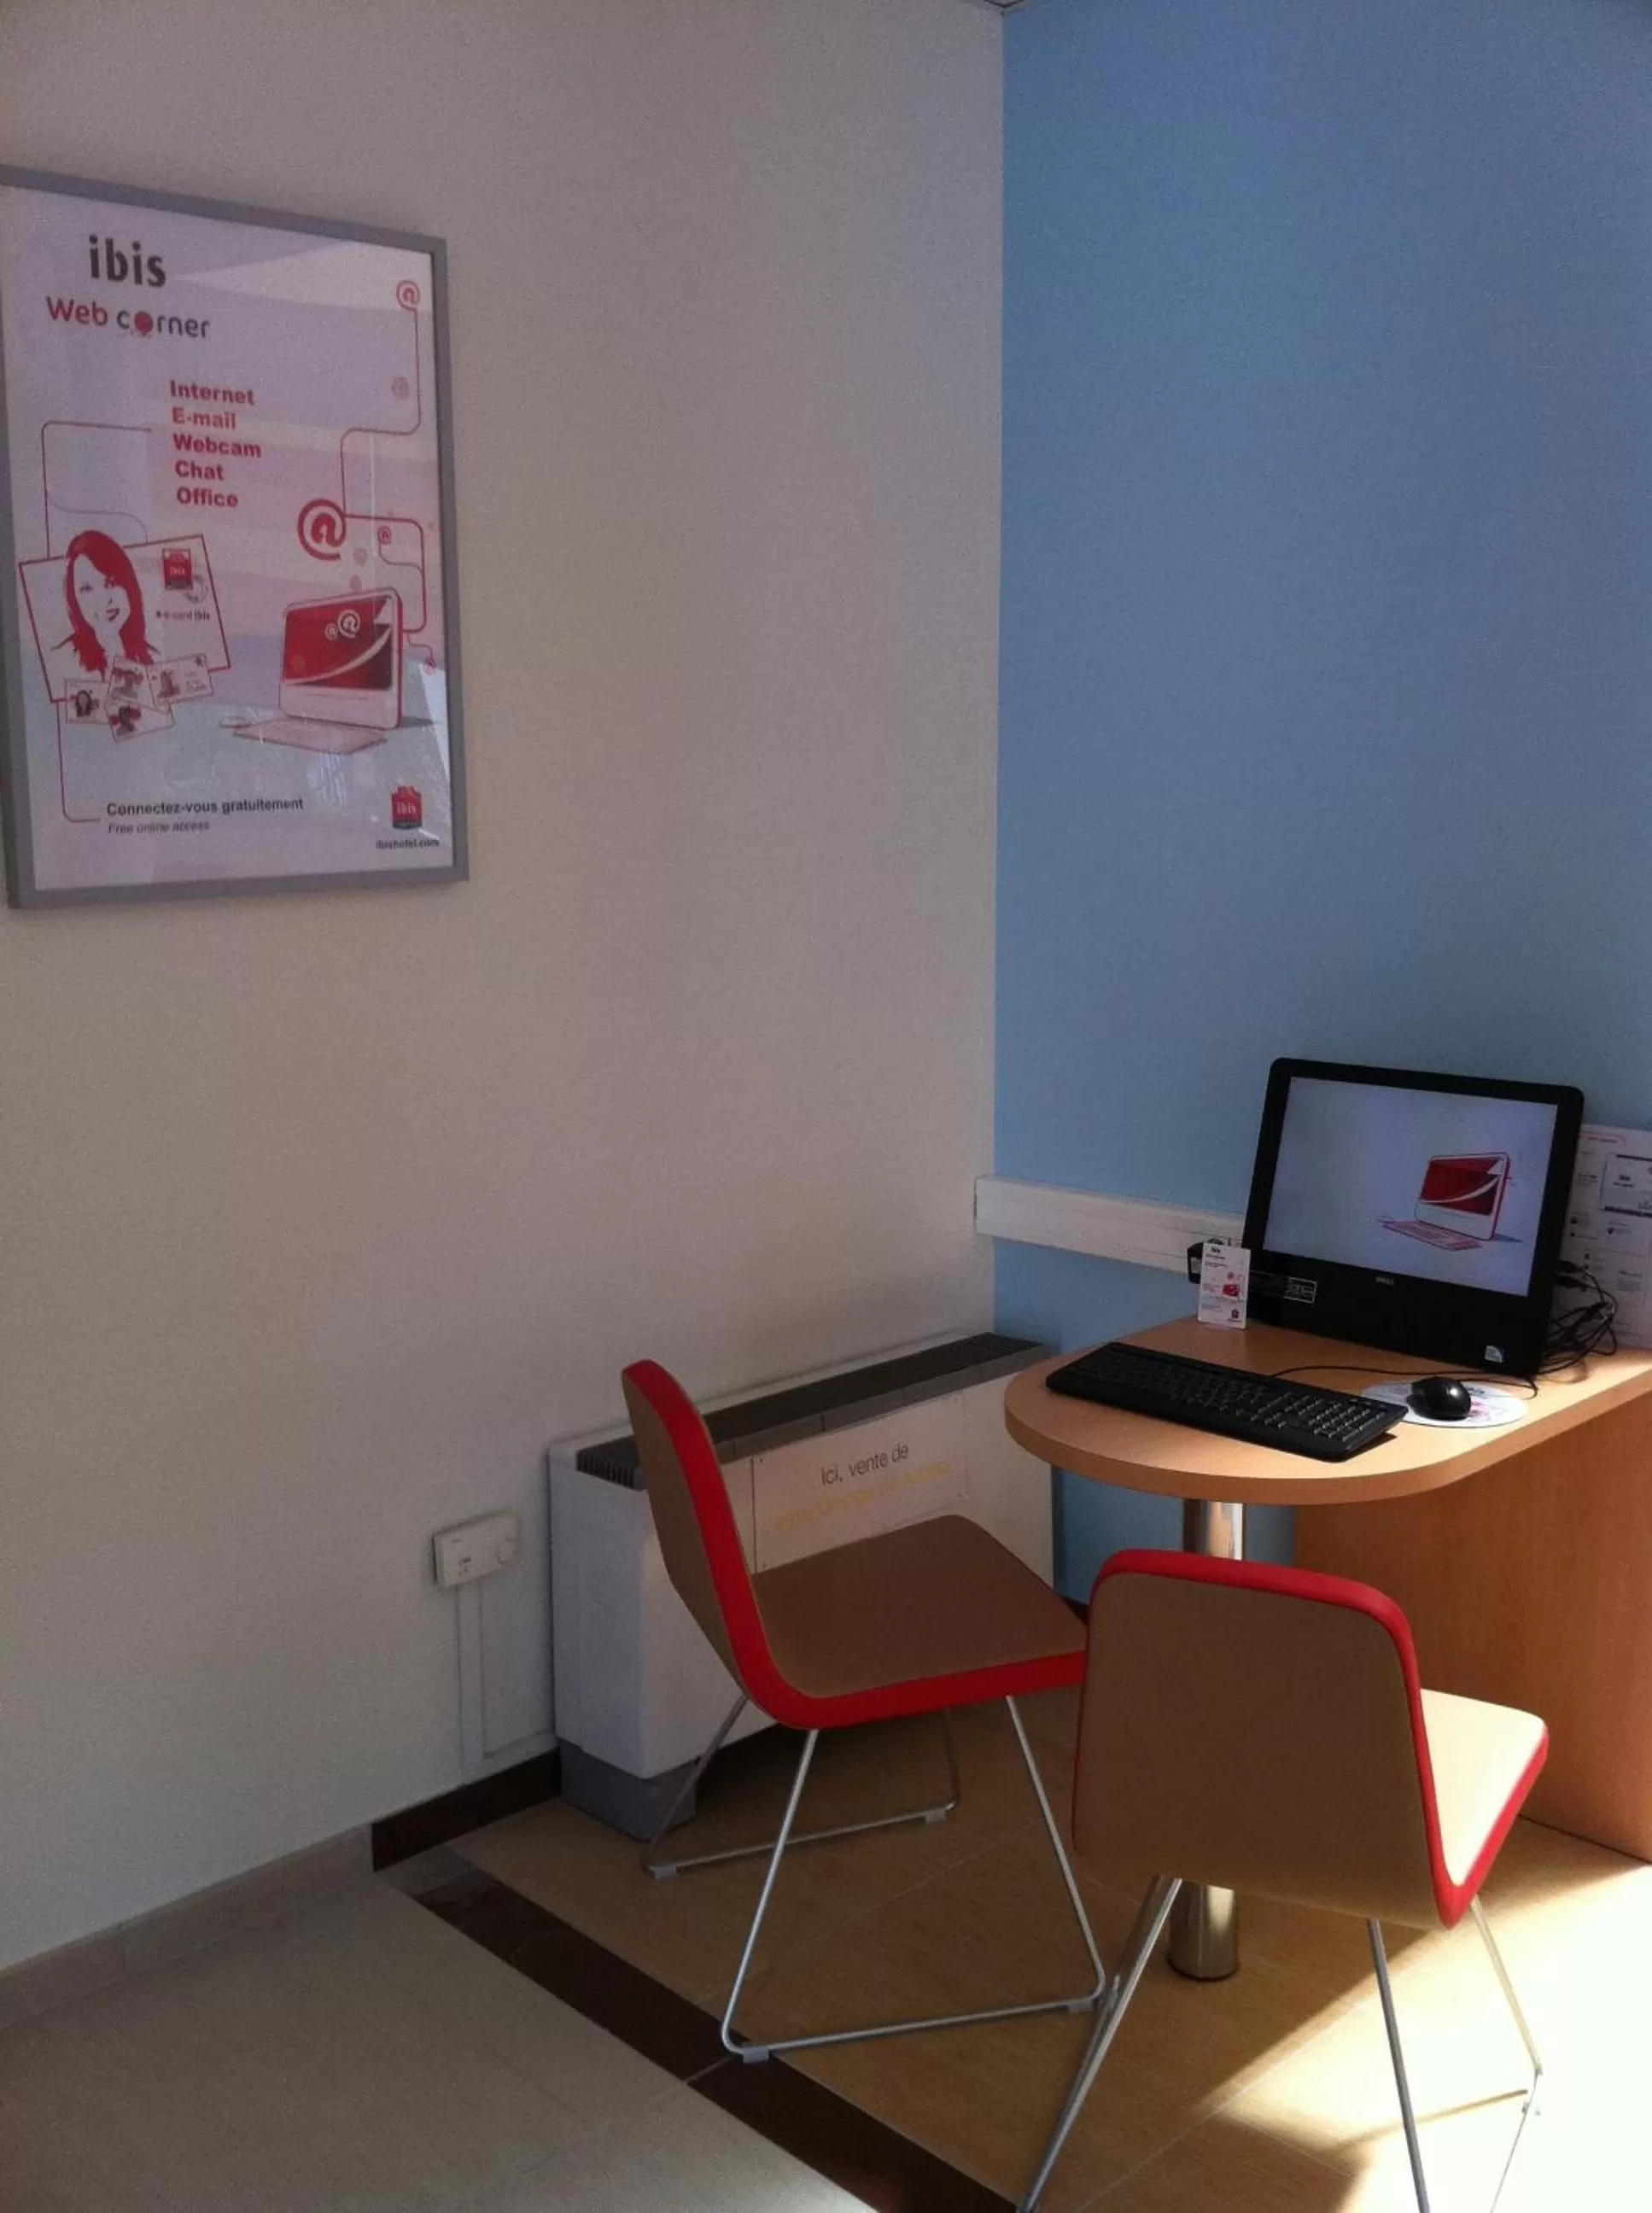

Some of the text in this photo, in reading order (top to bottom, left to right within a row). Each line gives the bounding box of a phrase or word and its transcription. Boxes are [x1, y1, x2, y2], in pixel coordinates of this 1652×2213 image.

[90, 234, 166, 288] ibis
[45, 295, 211, 339] Web corner
[170, 380, 255, 405] Internet
[172, 407, 236, 429] E-mail
[173, 434, 261, 458] Webcam
[175, 460, 225, 482] Chat
[177, 487, 238, 508] Office
[106, 797, 304, 816] Connectez-vous gratuitement
[849, 1452, 889, 1477] vente
[891, 1442, 909, 1463] de
